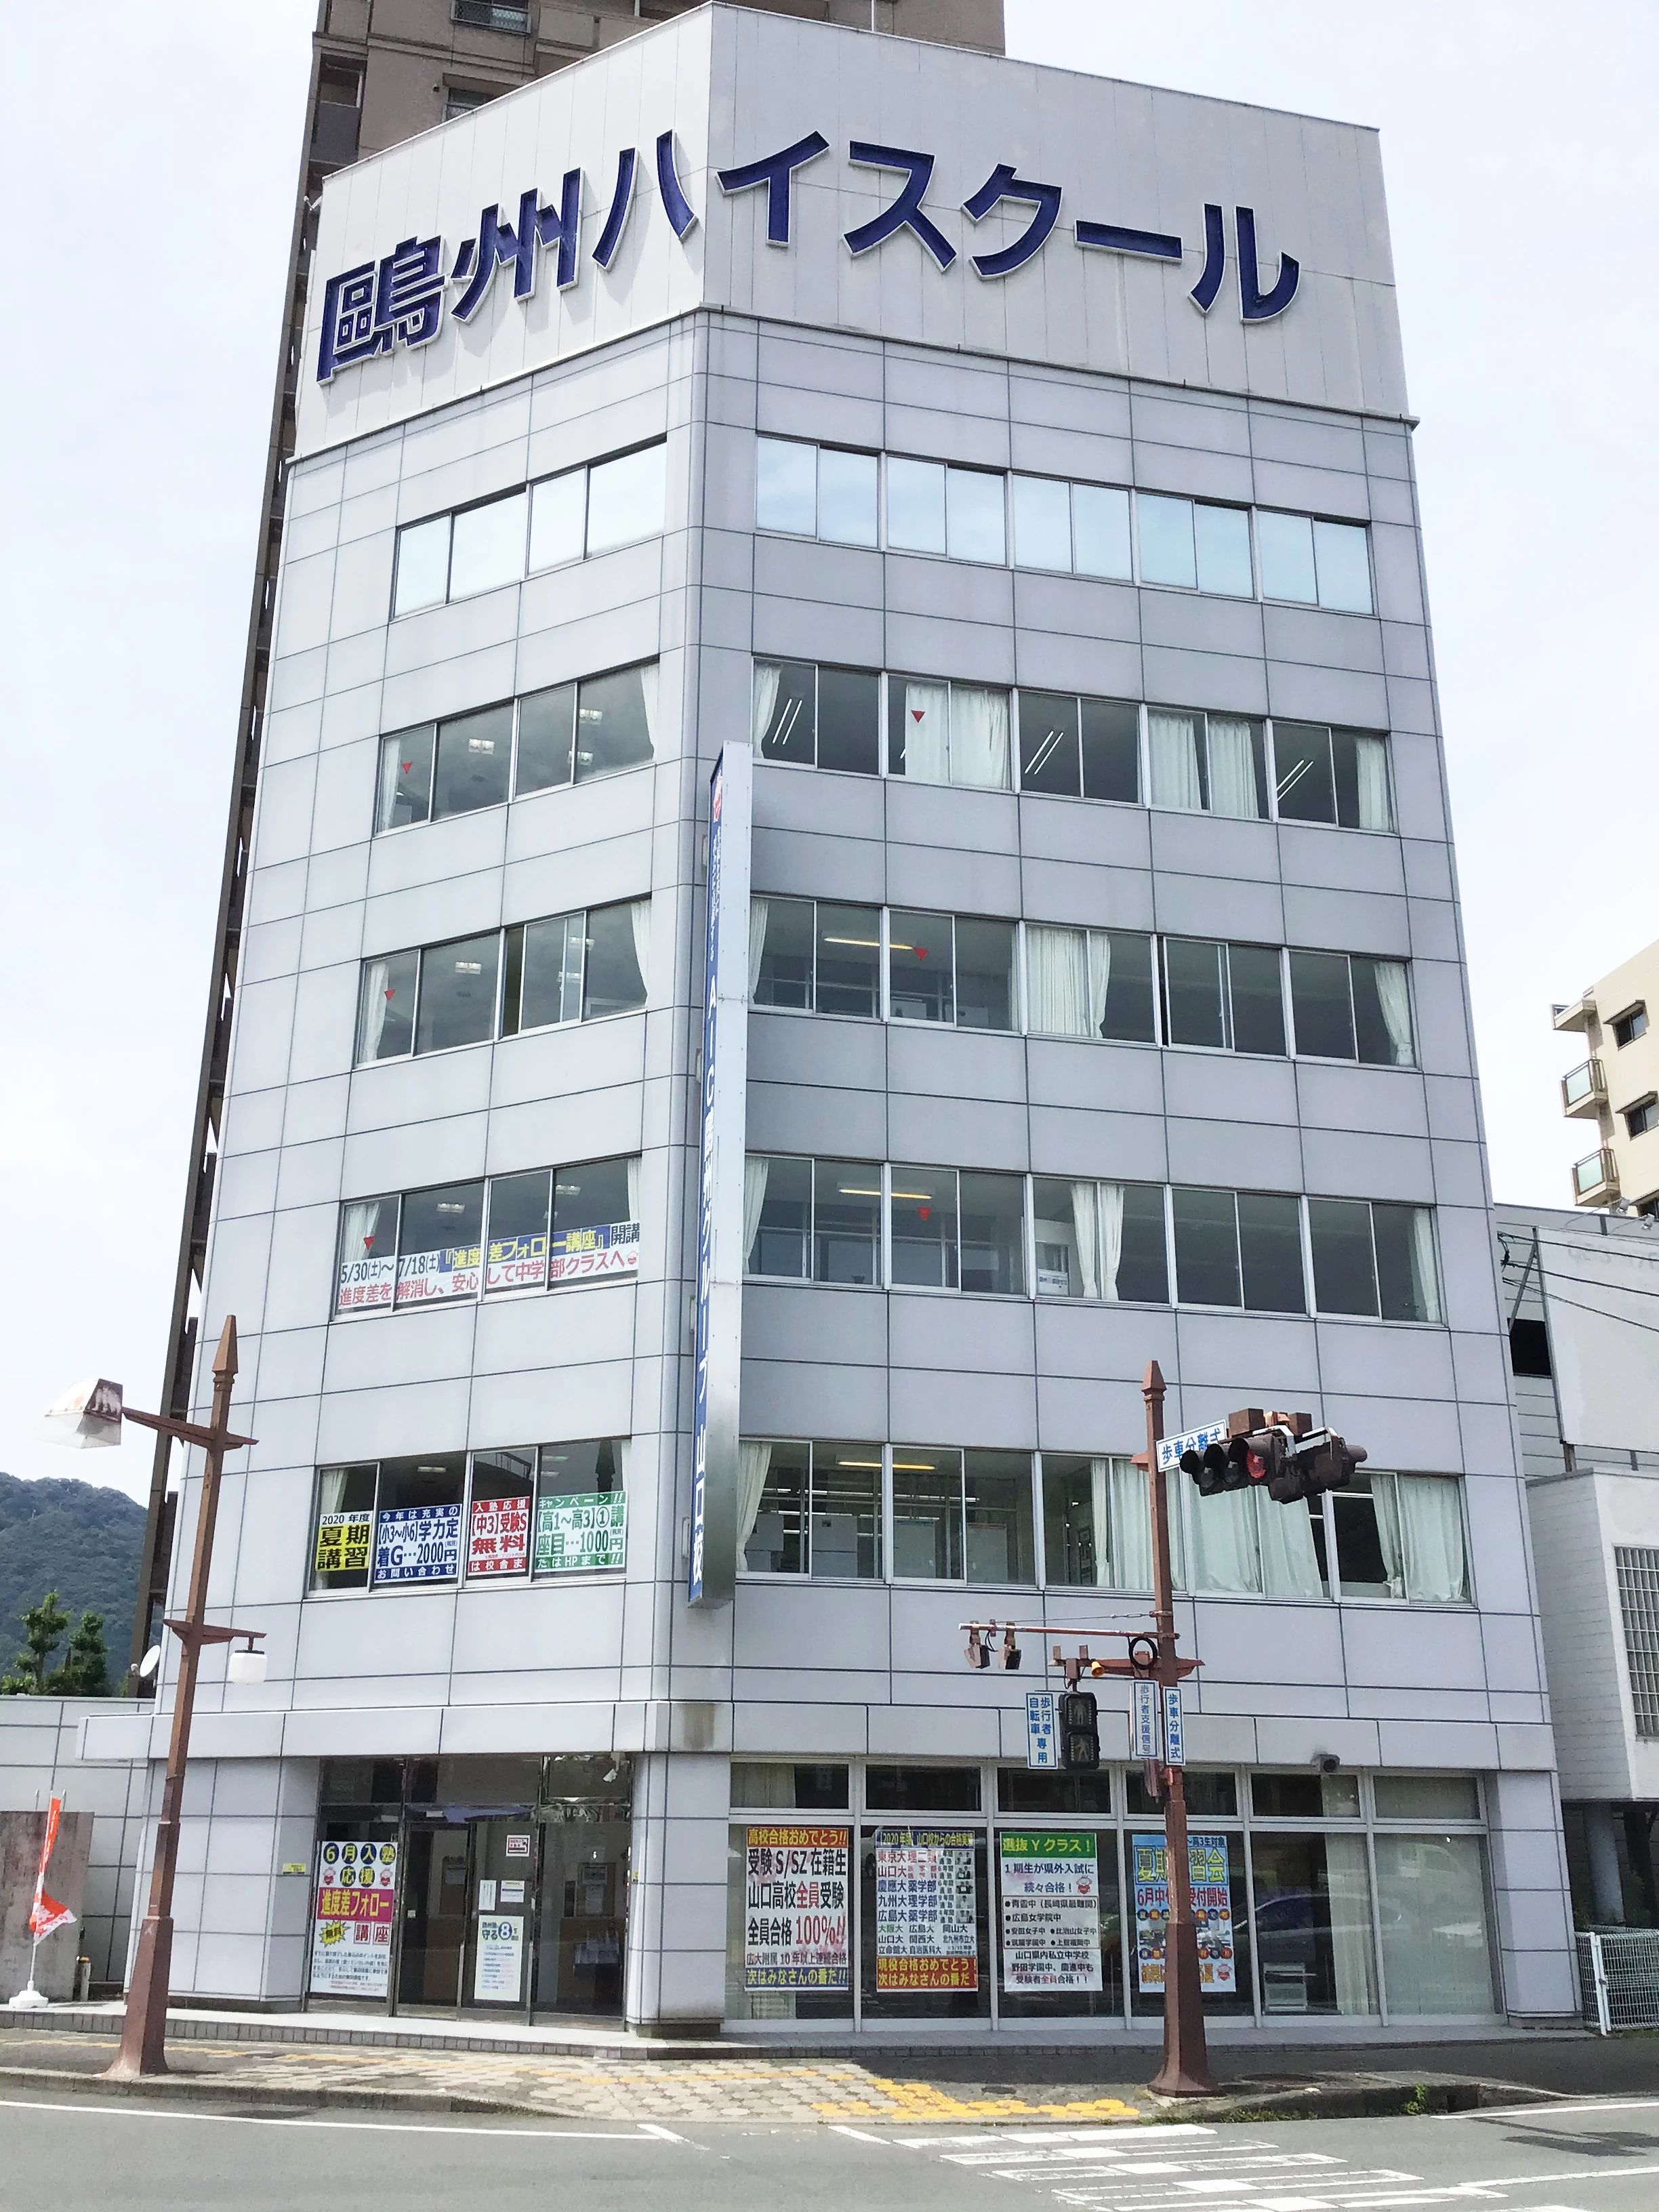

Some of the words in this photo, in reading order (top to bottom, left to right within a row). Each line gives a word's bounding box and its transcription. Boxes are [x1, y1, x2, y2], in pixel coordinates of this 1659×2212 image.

[382, 1506, 458, 1521] 今年は充実の
[474, 1498, 527, 1513] 入塾応援
[693, 1423, 706, 1586] 山口校
[322, 1514, 345, 1525] 2020
[348, 1513, 371, 1523] 年度
[319, 1524, 370, 1547] 夏期
[471, 1534, 525, 1555] 無料
[317, 1547, 369, 1569] 講習
[471, 1558, 523, 1572] は校舎ま
[377, 1564, 455, 1580] お問い合わせ
[1029, 1698, 1040, 1735] 自転車
[1040, 1697, 1052, 1735] 歩行者
[1139, 1684, 1151, 1755] 歩行者支援信号
[1168, 1693, 1181, 1759] 歩車分離式
[1037, 1738, 1048, 1764] 専用
[748, 1829, 846, 1846] 高校合格おめでとう!!
[325, 1843, 396, 1864] 6月入塾
[748, 1848, 773, 1876] 受験
[810, 1847, 846, 1876] 在籍生
[340, 1866, 375, 1886] 応援
[878, 1865, 907, 1878] 山口大
[321, 1889, 390, 1917] 進度差フォロー
[748, 1880, 844, 1910] 山口高校全員受験
[355, 1923, 390, 1944] 講座
[482, 1929, 498, 1941] 守る
[500, 1923, 511, 1940] 8
[747, 1917, 792, 1946] 全員合格
[878, 1924, 904, 1933] 大阪大
[909, 1924, 935, 1933] 広島大
[943, 1924, 968, 1933] 岡山大
[878, 1935, 904, 1944] 山口大
[909, 1935, 935, 1944] 関西大
[1015, 1950, 1090, 1960] 山口県内私立中学校
[747, 1967, 846, 1986] 次はみなさんの番だ!!
